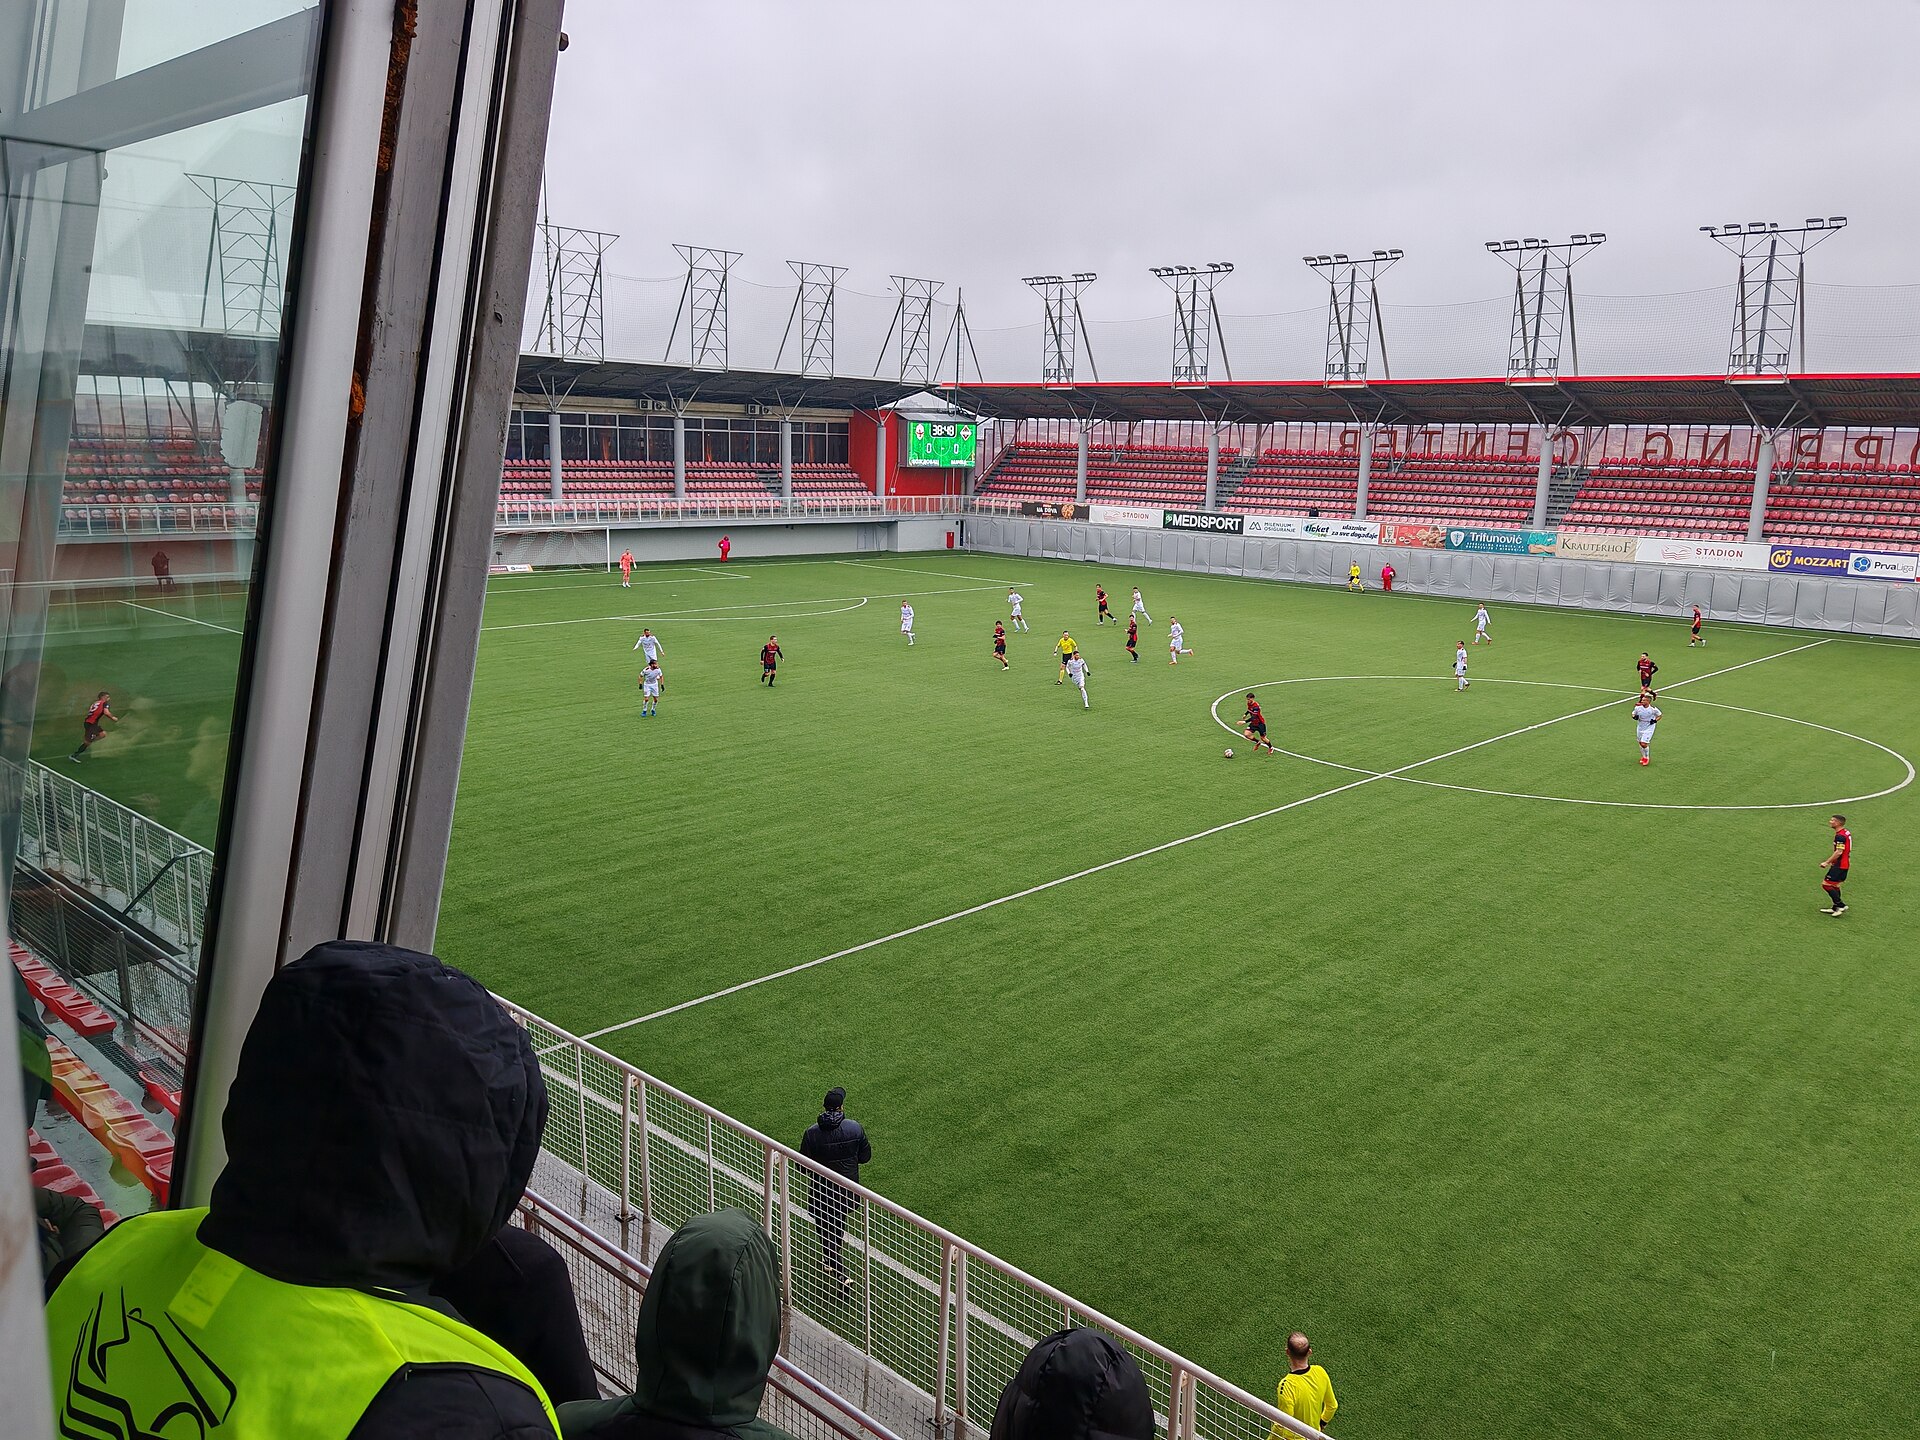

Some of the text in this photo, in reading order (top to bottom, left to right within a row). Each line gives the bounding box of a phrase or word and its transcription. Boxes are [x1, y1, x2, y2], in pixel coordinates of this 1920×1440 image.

[1122, 512, 1149, 520] STADION
[1172, 514, 1241, 531] MEDISPORT
[1305, 524, 1330, 533] ticket
[1470, 532, 1522, 544] Trifunović
[1696, 548, 1743, 557] STADION
[1794, 556, 1849, 568] MOZZART
[1874, 561, 1914, 573] PrvaLiga
